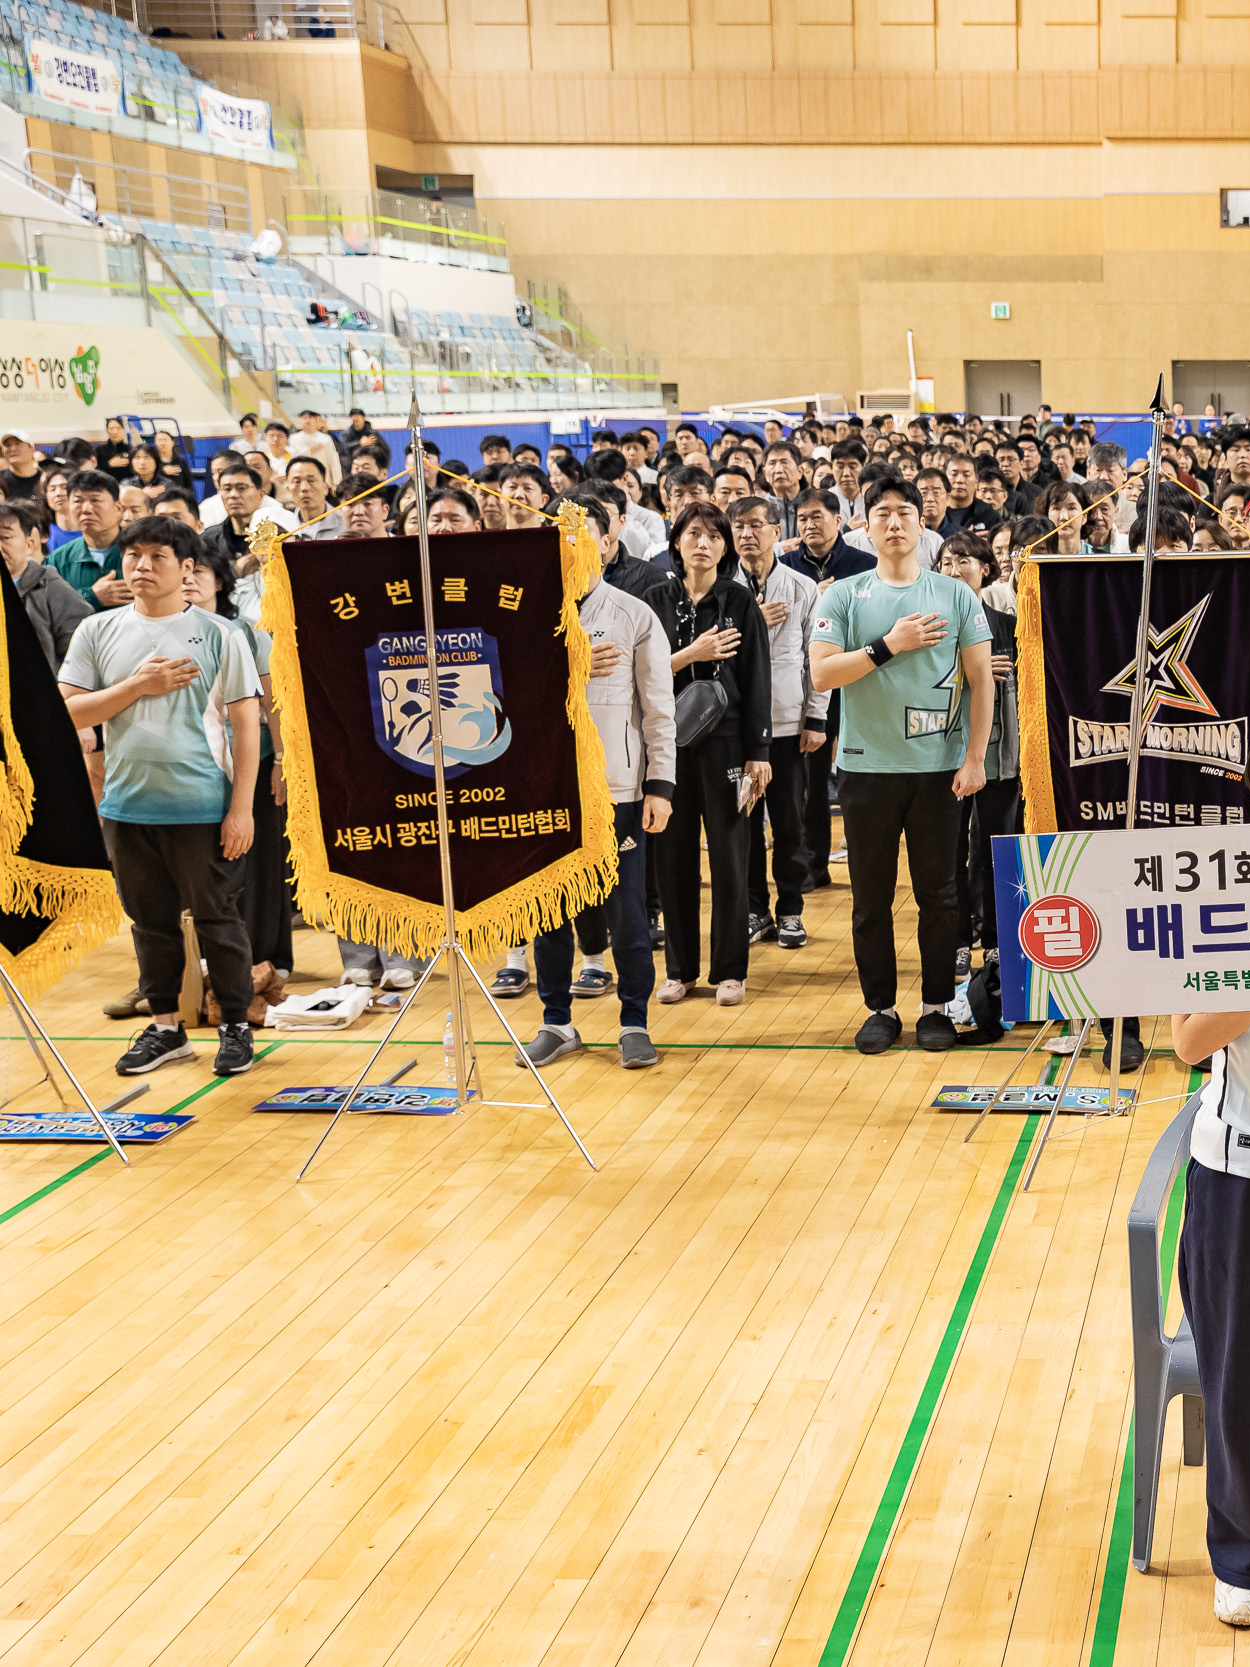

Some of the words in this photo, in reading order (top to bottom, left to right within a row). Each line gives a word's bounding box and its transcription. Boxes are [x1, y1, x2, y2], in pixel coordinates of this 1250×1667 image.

[378, 632, 483, 654] GANGYEON
[388, 653, 449, 666] BADMINON
[451, 651, 478, 662] CLUB
[909, 711, 948, 735] STAR
[1076, 721, 1130, 758] STAR
[1146, 723, 1242, 764] MORNING
[1200, 766, 1225, 776] SINCE
[1225, 771, 1243, 782] 2002
[395, 790, 454, 809] SINCE
[459, 787, 506, 803] 2002
[334, 823, 392, 851] 서울시
[460, 808, 571, 840] 배드민턴협회
[1032, 906, 1083, 958] 필
